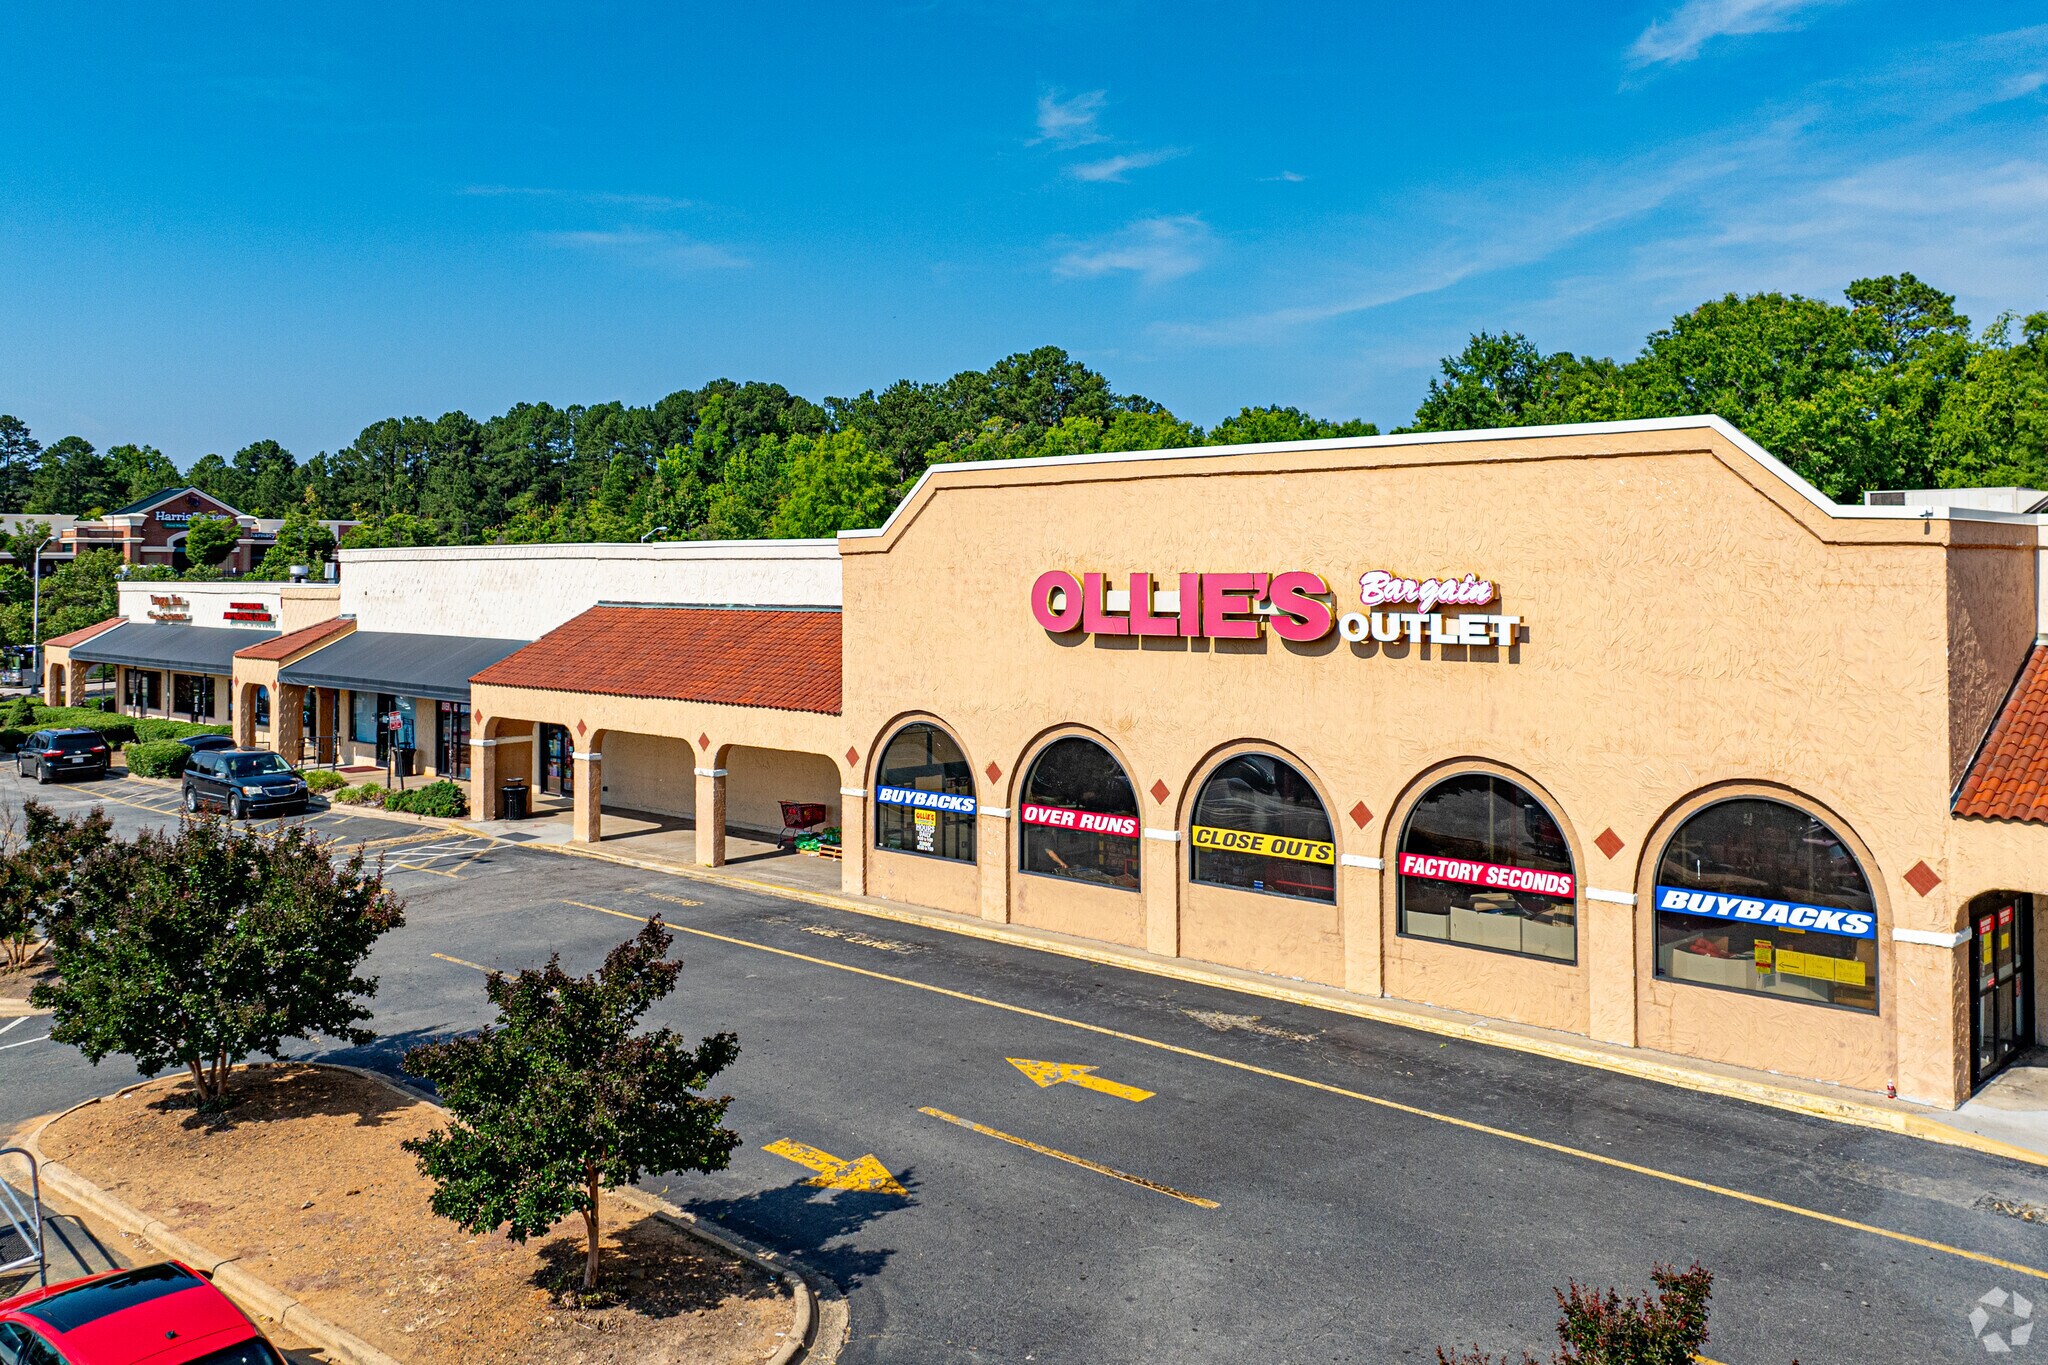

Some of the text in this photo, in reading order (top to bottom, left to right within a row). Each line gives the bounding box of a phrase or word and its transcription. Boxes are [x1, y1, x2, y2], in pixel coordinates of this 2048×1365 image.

[155, 511, 192, 521] Harris
[1031, 569, 1336, 642] OLLIE'S
[1359, 570, 1495, 615] Bargain
[1339, 612, 1520, 646] OUTLET
[879, 788, 976, 812] BUYBACKS
[1024, 806, 1136, 835] OVER RUNS
[1196, 829, 1332, 861] CLOSE OUTS
[1403, 856, 1572, 895] FACTORY SECONDS
[1661, 890, 1873, 935] BUYBACKS
